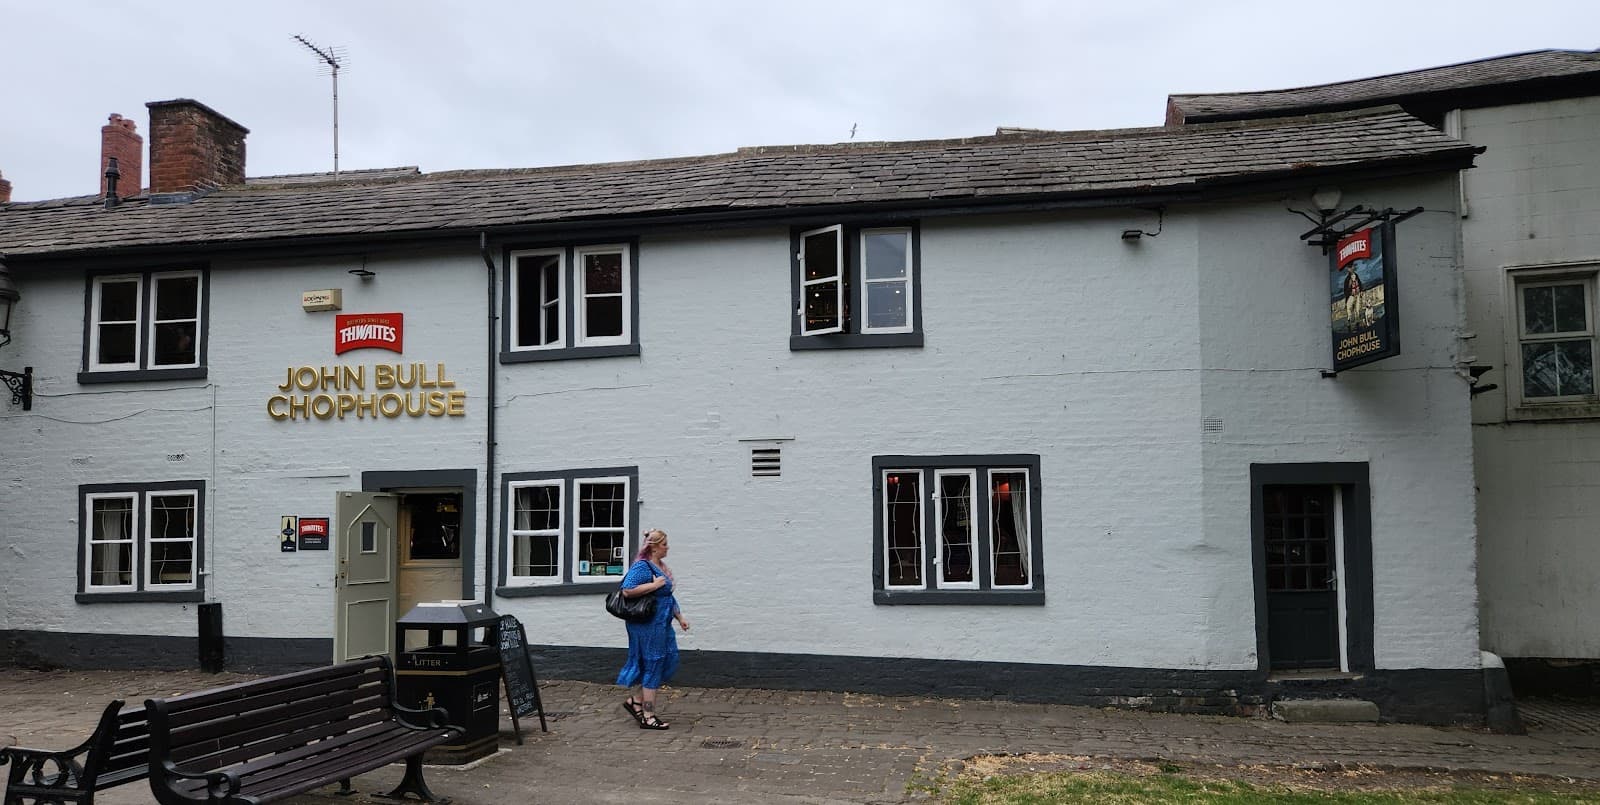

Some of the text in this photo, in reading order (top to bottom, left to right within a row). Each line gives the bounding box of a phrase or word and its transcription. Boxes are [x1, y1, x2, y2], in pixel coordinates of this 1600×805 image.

[340, 324, 396, 344] THWAITES
[1339, 329, 1378, 350] JOHN BULL
[1337, 339, 1381, 361] CHOPHOUSE
[279, 363, 455, 393] JOHN BULL
[267, 391, 466, 420] CHOPHOUSE
[414, 659, 441, 667] LITTER
